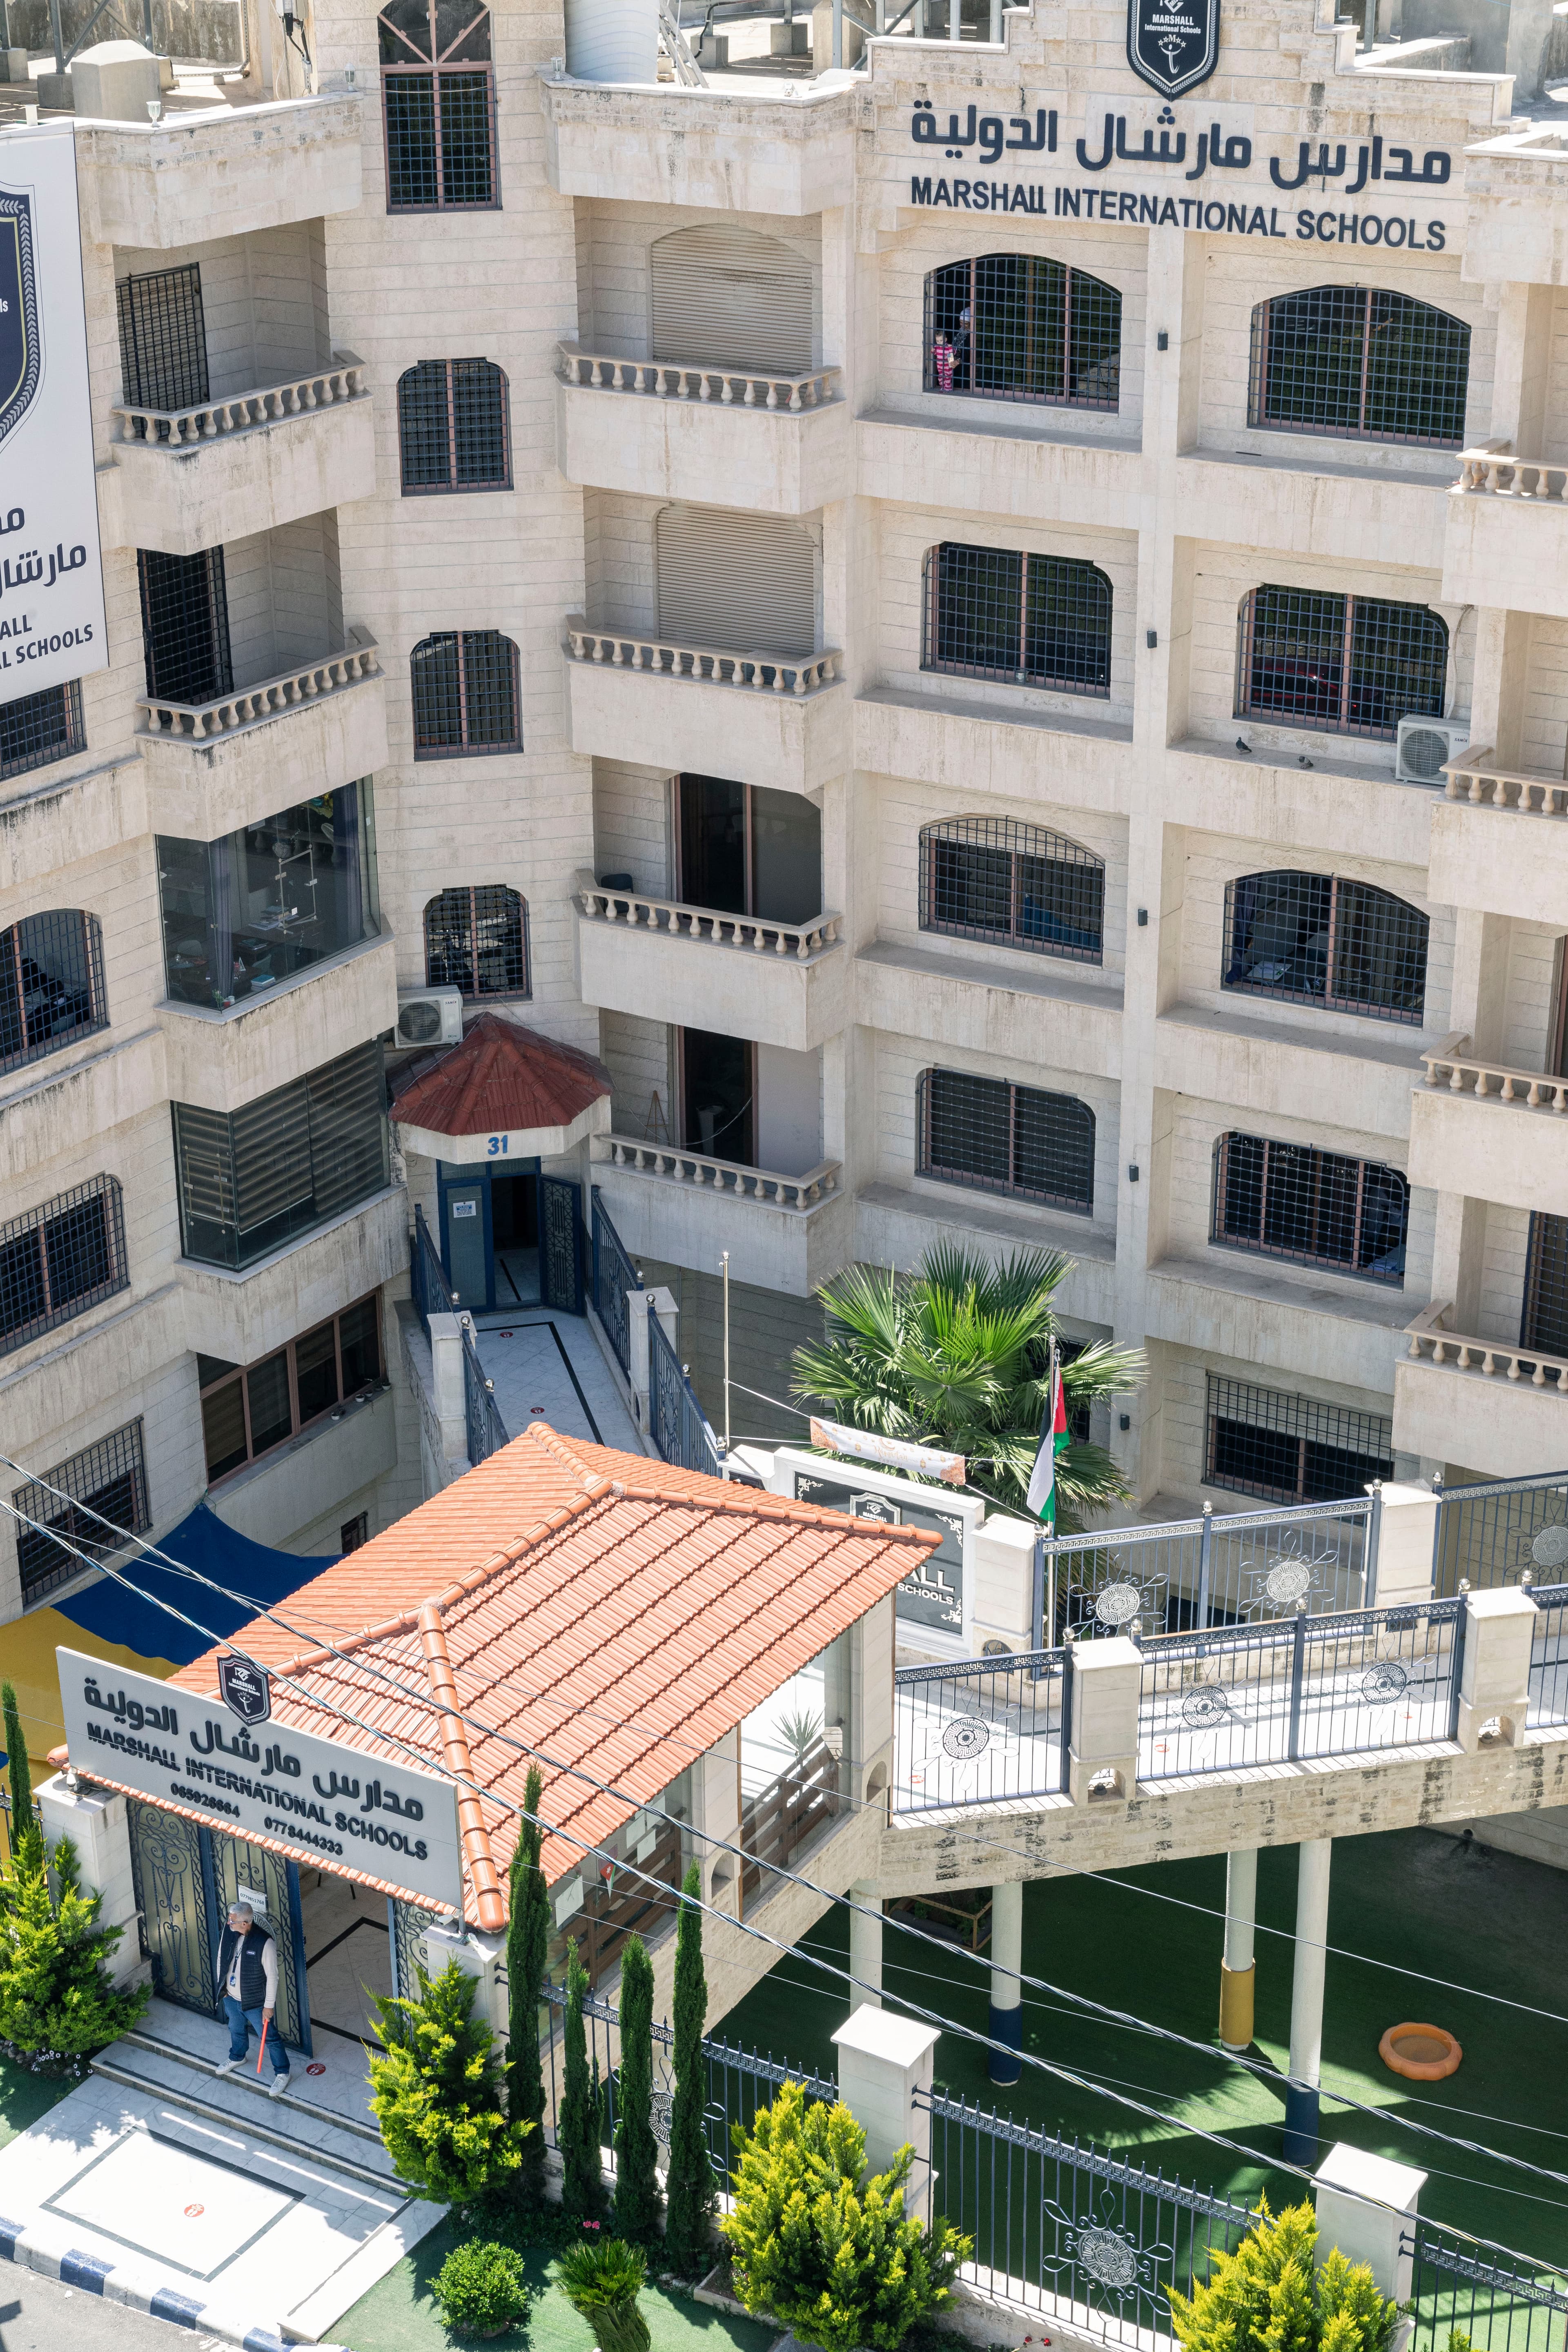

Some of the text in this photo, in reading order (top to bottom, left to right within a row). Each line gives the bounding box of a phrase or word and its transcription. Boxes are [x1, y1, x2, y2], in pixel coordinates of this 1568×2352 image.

[1145, 24, 1179, 32] International
[1152, 14, 1194, 25] MARSHALL
[912, 100, 1451, 194] مدارس مارشال الدولية
[912, 176, 1446, 251] MARSHALL INTERNATIONAL SCHOOLS
[0, 543, 86, 599] مارشا
[17, 624, 93, 664] SCHOOLS
[488, 1135, 508, 1155] 31
[863, 1512, 887, 1522] MARSHALL
[898, 1582, 954, 1605] SCHOOLS
[232, 1678, 256, 1690] MARSHALL
[84, 1677, 423, 1821] مدارس مارشال الدولية
[87, 1722, 428, 1860] MARSHALL INTERNATIONAL SCHOOLS
[264, 1817, 343, 1856] 0778444333
[240, 1893, 264, 1905] 0779851768
